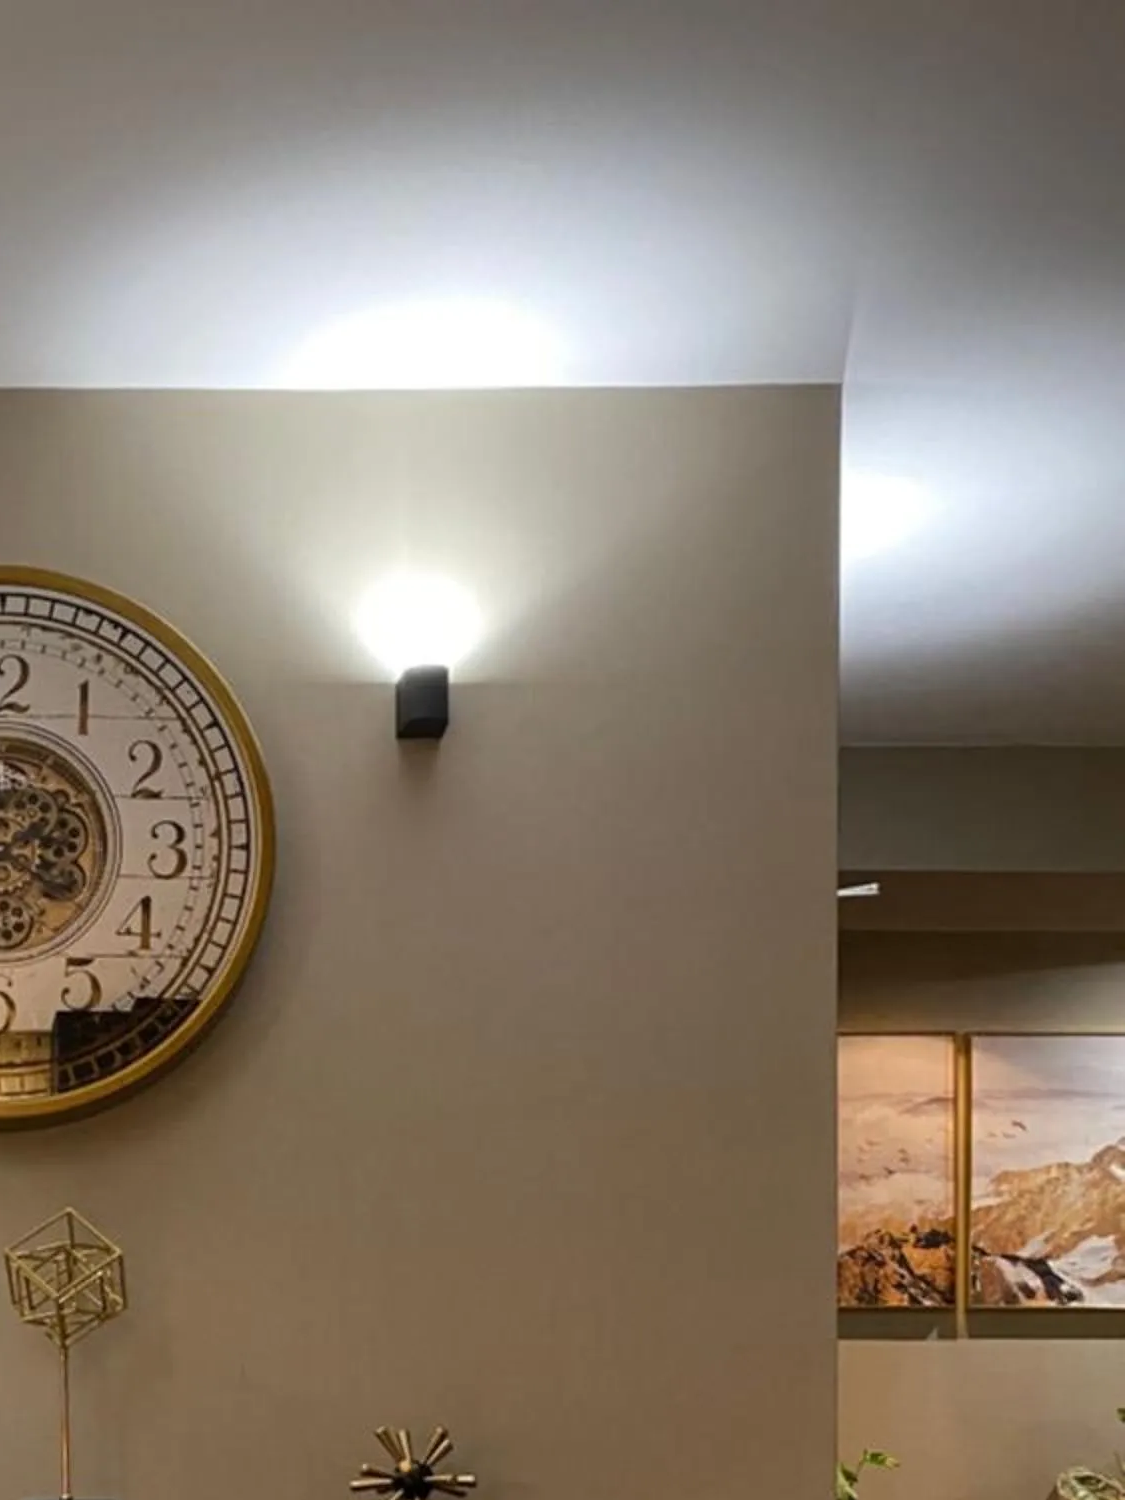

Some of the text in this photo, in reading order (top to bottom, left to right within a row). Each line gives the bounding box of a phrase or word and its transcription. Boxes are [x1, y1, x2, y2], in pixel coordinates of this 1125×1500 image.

[76, 680, 90, 735] 1
[128, 740, 163, 799] 2
[148, 820, 187, 879] 3
[114, 895, 162, 950] 4
[60, 956, 101, 1011] 5
